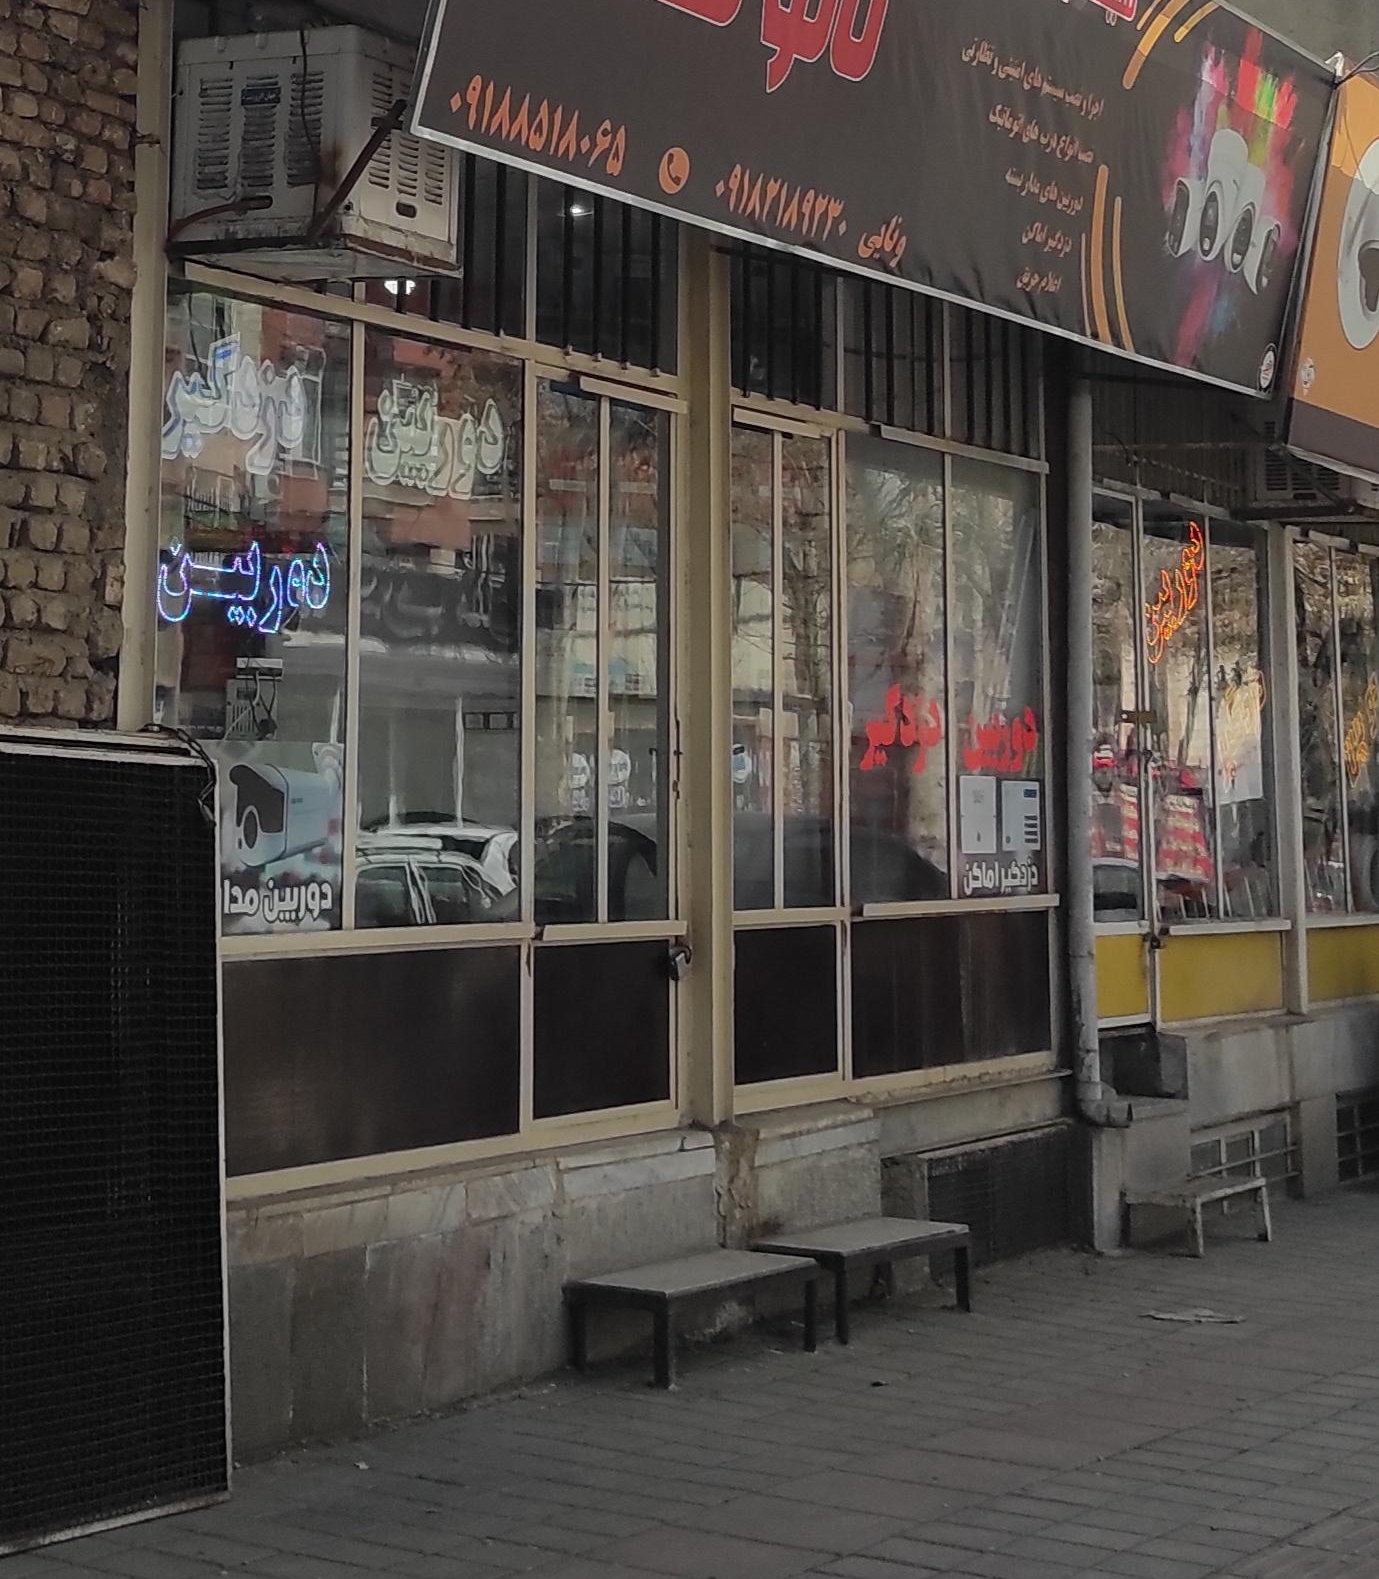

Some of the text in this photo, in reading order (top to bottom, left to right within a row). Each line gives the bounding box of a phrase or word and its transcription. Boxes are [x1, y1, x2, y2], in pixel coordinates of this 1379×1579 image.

[450, 74, 626, 177] ۰۹۱۸۸۵۱۸۰۶۵
[715, 163, 847, 242] ۰۹۱۸۲۱۸۹۲۳۰
[365, 389, 504, 500] دوربین
[157, 536, 330, 633] دوربین
[263, 878, 333, 924] دوربین
[964, 861, 999, 895] اماکن
